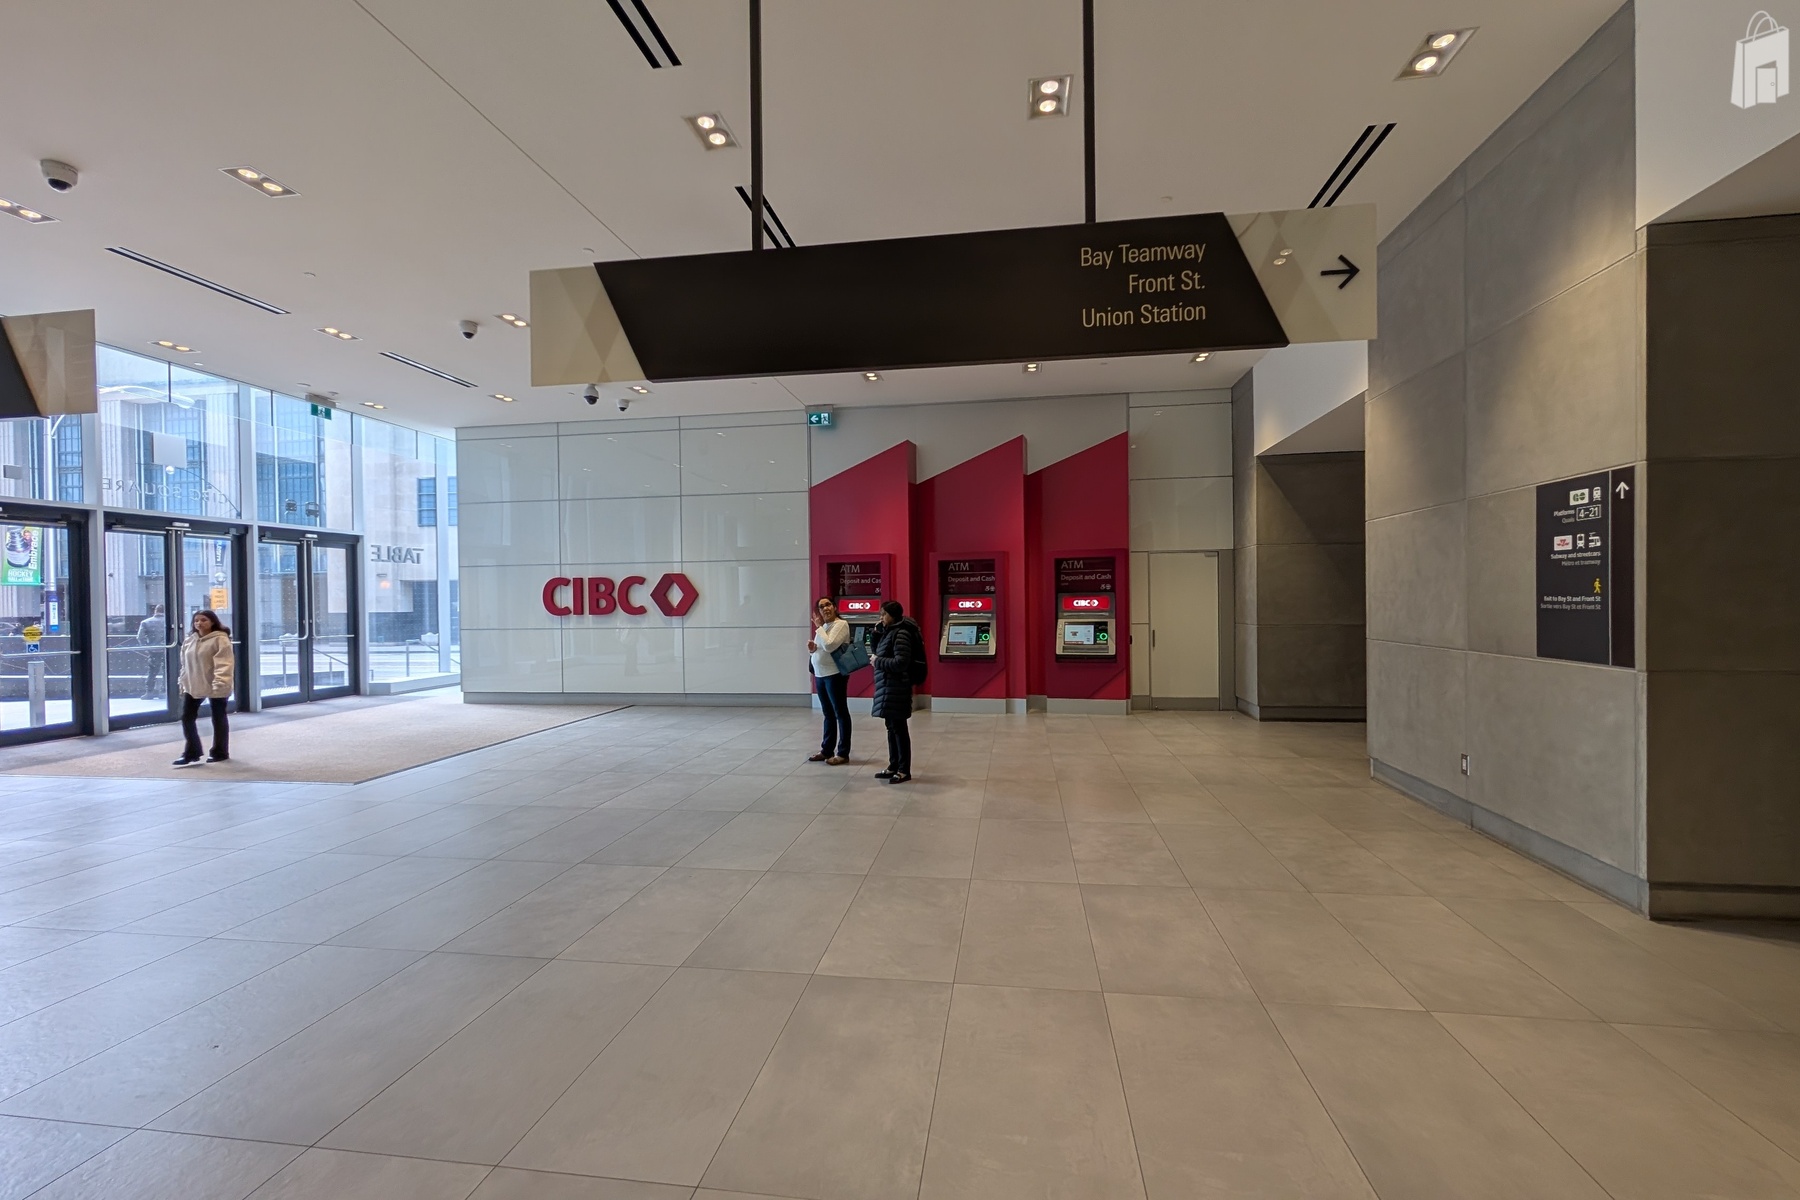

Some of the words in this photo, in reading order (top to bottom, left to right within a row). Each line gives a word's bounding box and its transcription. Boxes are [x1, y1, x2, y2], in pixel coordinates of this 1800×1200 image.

[1081, 247, 1114, 269] Bay
[1118, 243, 1206, 263] Teamway
[1129, 273, 1175, 294] Front
[1181, 270, 1206, 291] St.
[1082, 306, 1134, 328] Union
[1140, 302, 1206, 324] Station
[1572, 492, 1586, 502] GO
[1578, 506, 1599, 519] 4-21
[28, 530, 39, 570] Embrace
[840, 564, 860, 573] ATM
[948, 562, 969, 571] ATM
[1060, 560, 1084, 569] ATM
[8, 570, 34, 578] HOCKEY
[840, 577, 860, 586] Deposit
[541, 575, 648, 617] CIBC
